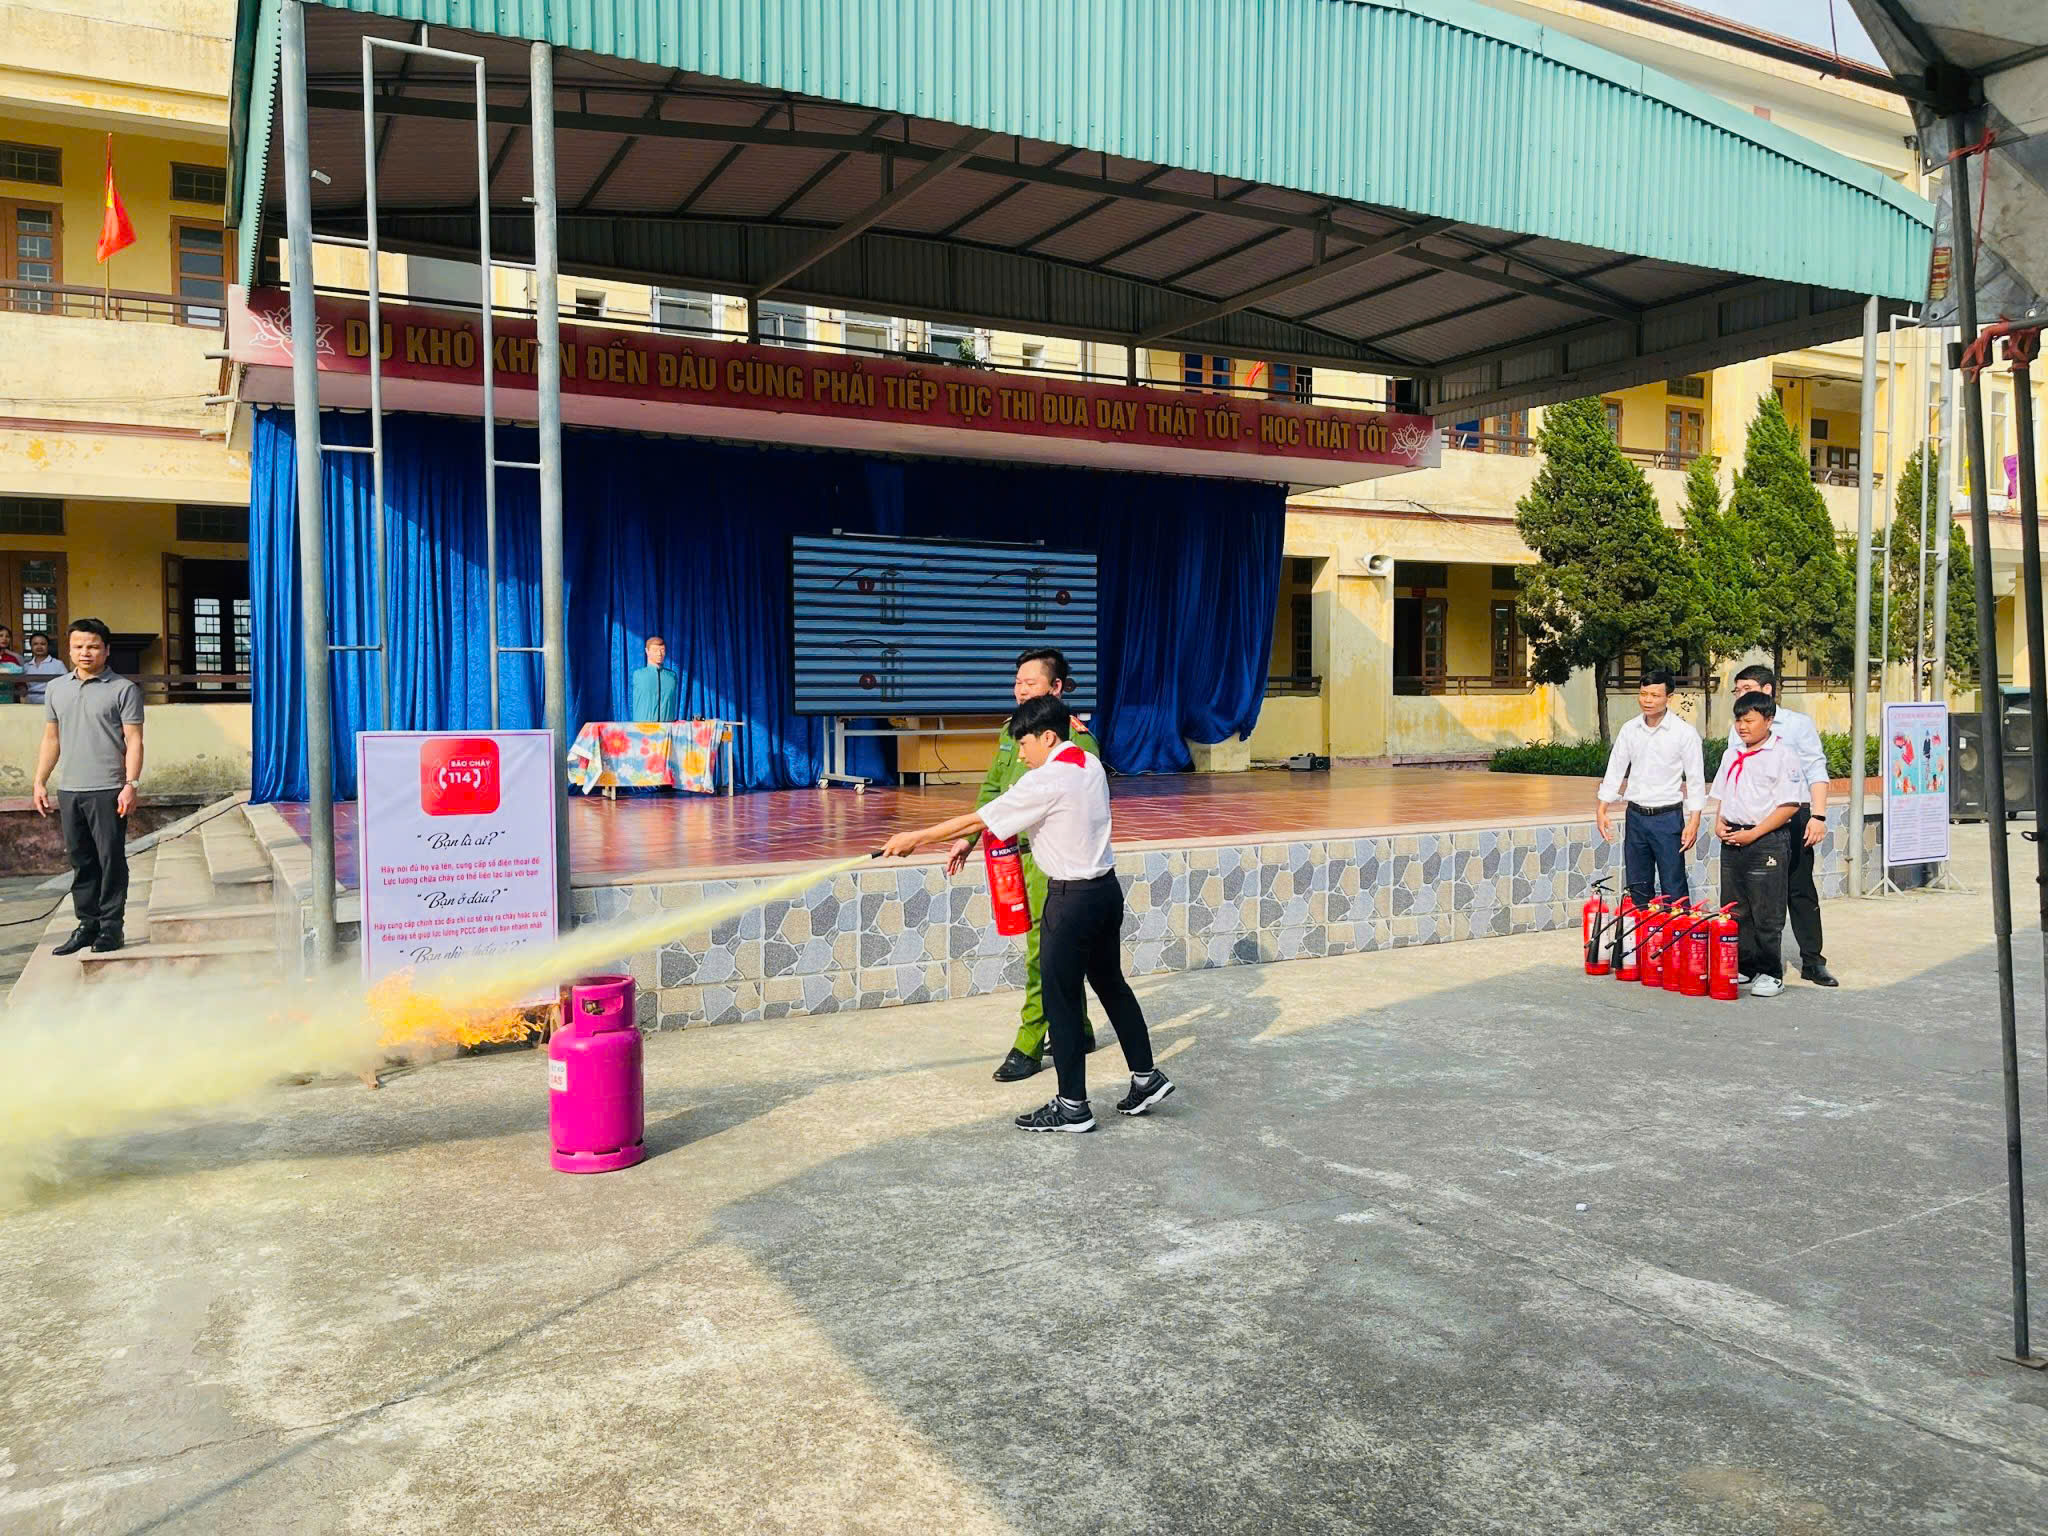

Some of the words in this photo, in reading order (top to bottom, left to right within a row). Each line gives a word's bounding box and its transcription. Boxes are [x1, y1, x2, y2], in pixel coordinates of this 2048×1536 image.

[406, 323, 474, 368] KHÓ
[493, 336, 577, 379] KHN
[587, 337, 648, 385] ĐẾN
[657, 347, 717, 391] ĐÂU
[813, 361, 875, 407] PHẢI
[883, 370, 938, 411] TIẾP
[945, 383, 992, 422] TỤC
[999, 389, 1036, 421] THI
[1043, 395, 1089, 427] ĐUA
[1096, 399, 1138, 436] DẠY
[1146, 401, 1197, 441] THẬT
[1204, 402, 1241, 440] TỐT
[1261, 415, 1299, 449] HỌC
[1305, 416, 1351, 453] THẬT
[1356, 416, 1389, 453] TỐT
[448, 772, 472, 784] 114
[427, 832, 459, 850] Bạn
[423, 891, 455, 909] Bạn
